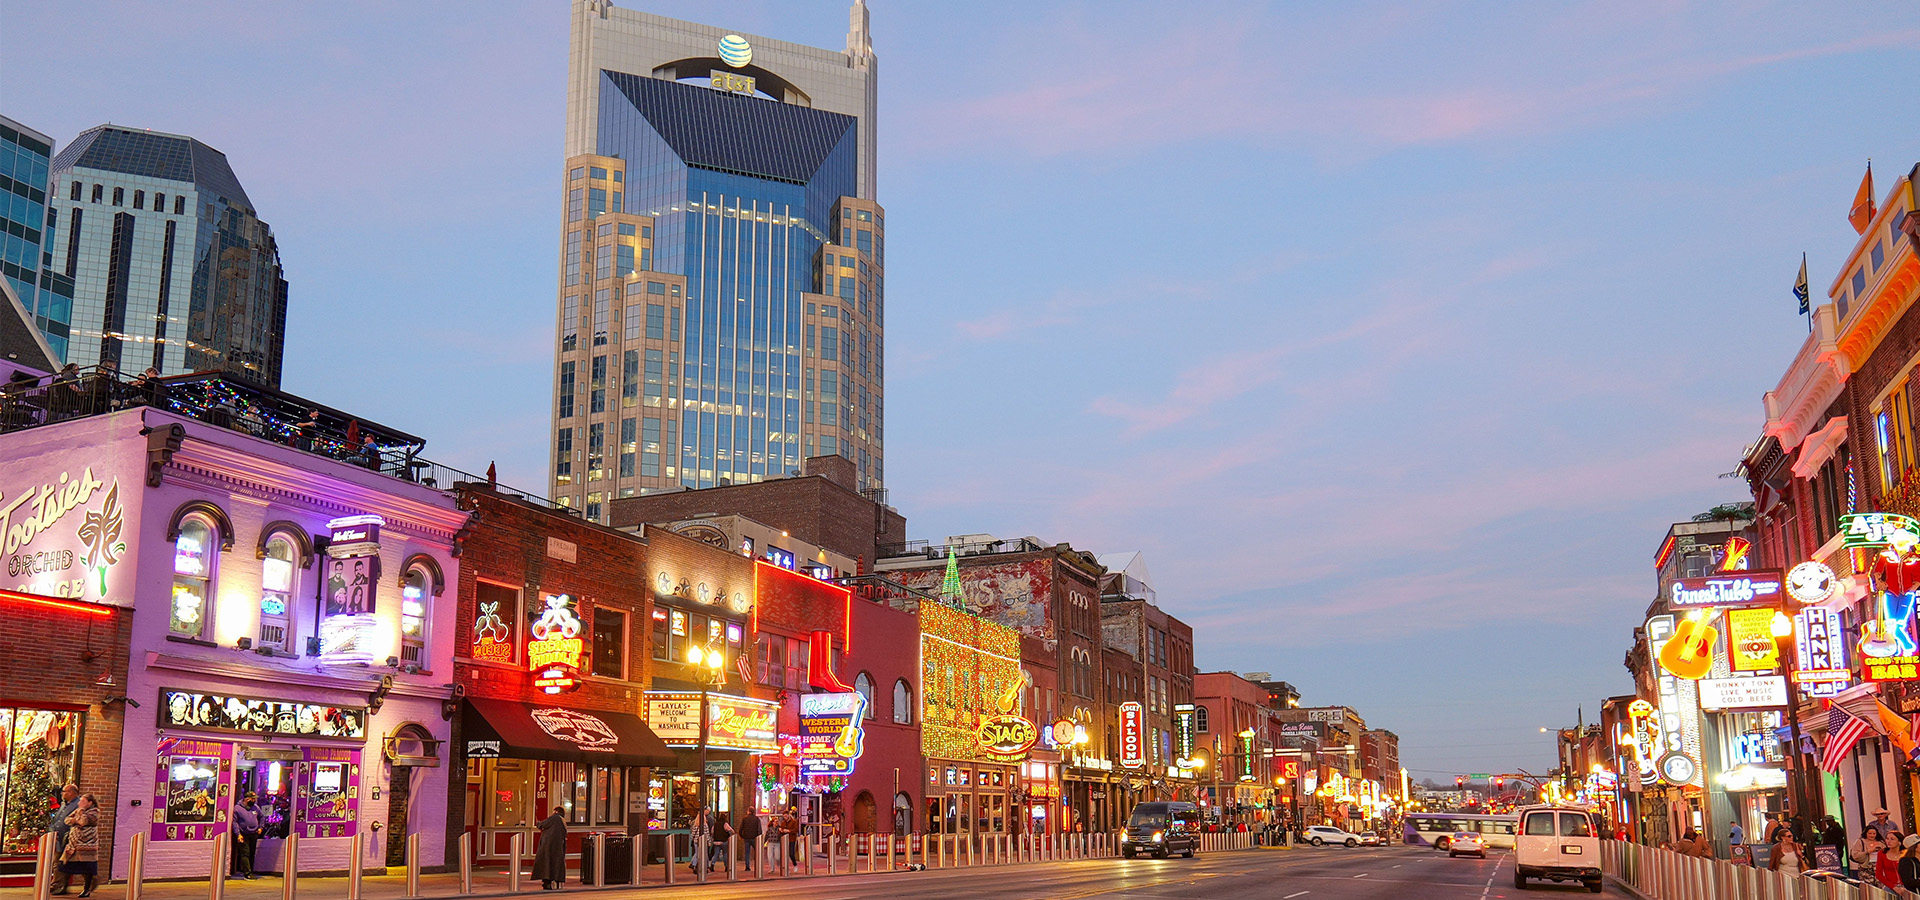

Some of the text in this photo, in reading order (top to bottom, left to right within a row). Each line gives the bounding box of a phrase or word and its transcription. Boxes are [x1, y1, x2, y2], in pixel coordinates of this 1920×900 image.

[712, 73, 755, 94] at&t
[8, 550, 74, 578] ORCHID
[1673, 579, 1753, 604] Ernest Tubb
[1807, 609, 1829, 669] HANK
[1865, 658, 1892, 666] GOOD
[1870, 664, 1918, 680] BAR
[713, 707, 775, 738] Layla's
[802, 718, 849, 726] WESTERN
[808, 726, 843, 734] WORLD
[977, 721, 1037, 747] STAGE
[1125, 711, 1137, 759] SALOON
